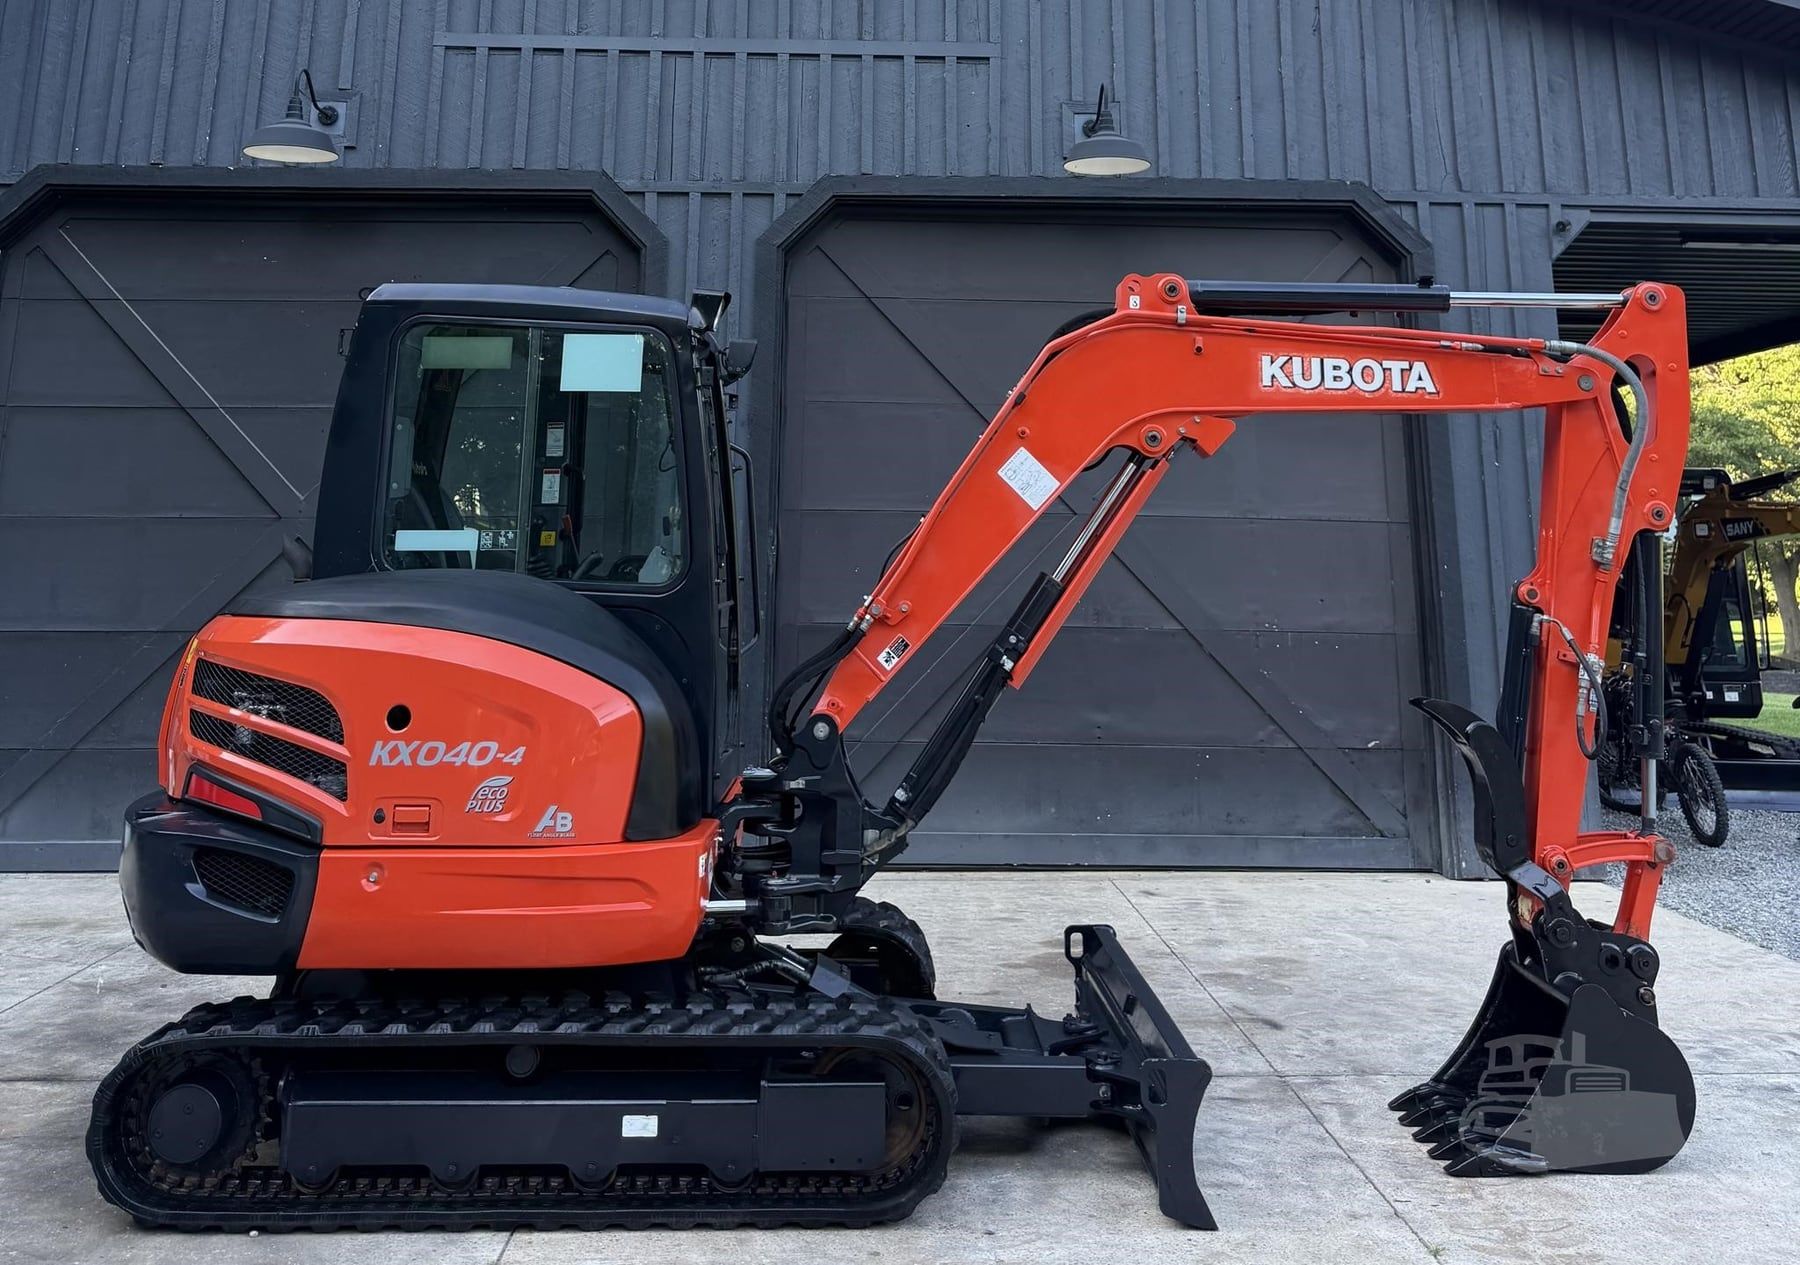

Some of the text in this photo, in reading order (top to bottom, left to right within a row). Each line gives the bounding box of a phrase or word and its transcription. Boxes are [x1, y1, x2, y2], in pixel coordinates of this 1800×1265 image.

[1261, 355, 1439, 395] KUBOTA
[1726, 520, 1754, 537] SANY
[369, 740, 527, 766] KX040-4
[478, 787, 508, 800] eco
[465, 800, 505, 813] PLUS
